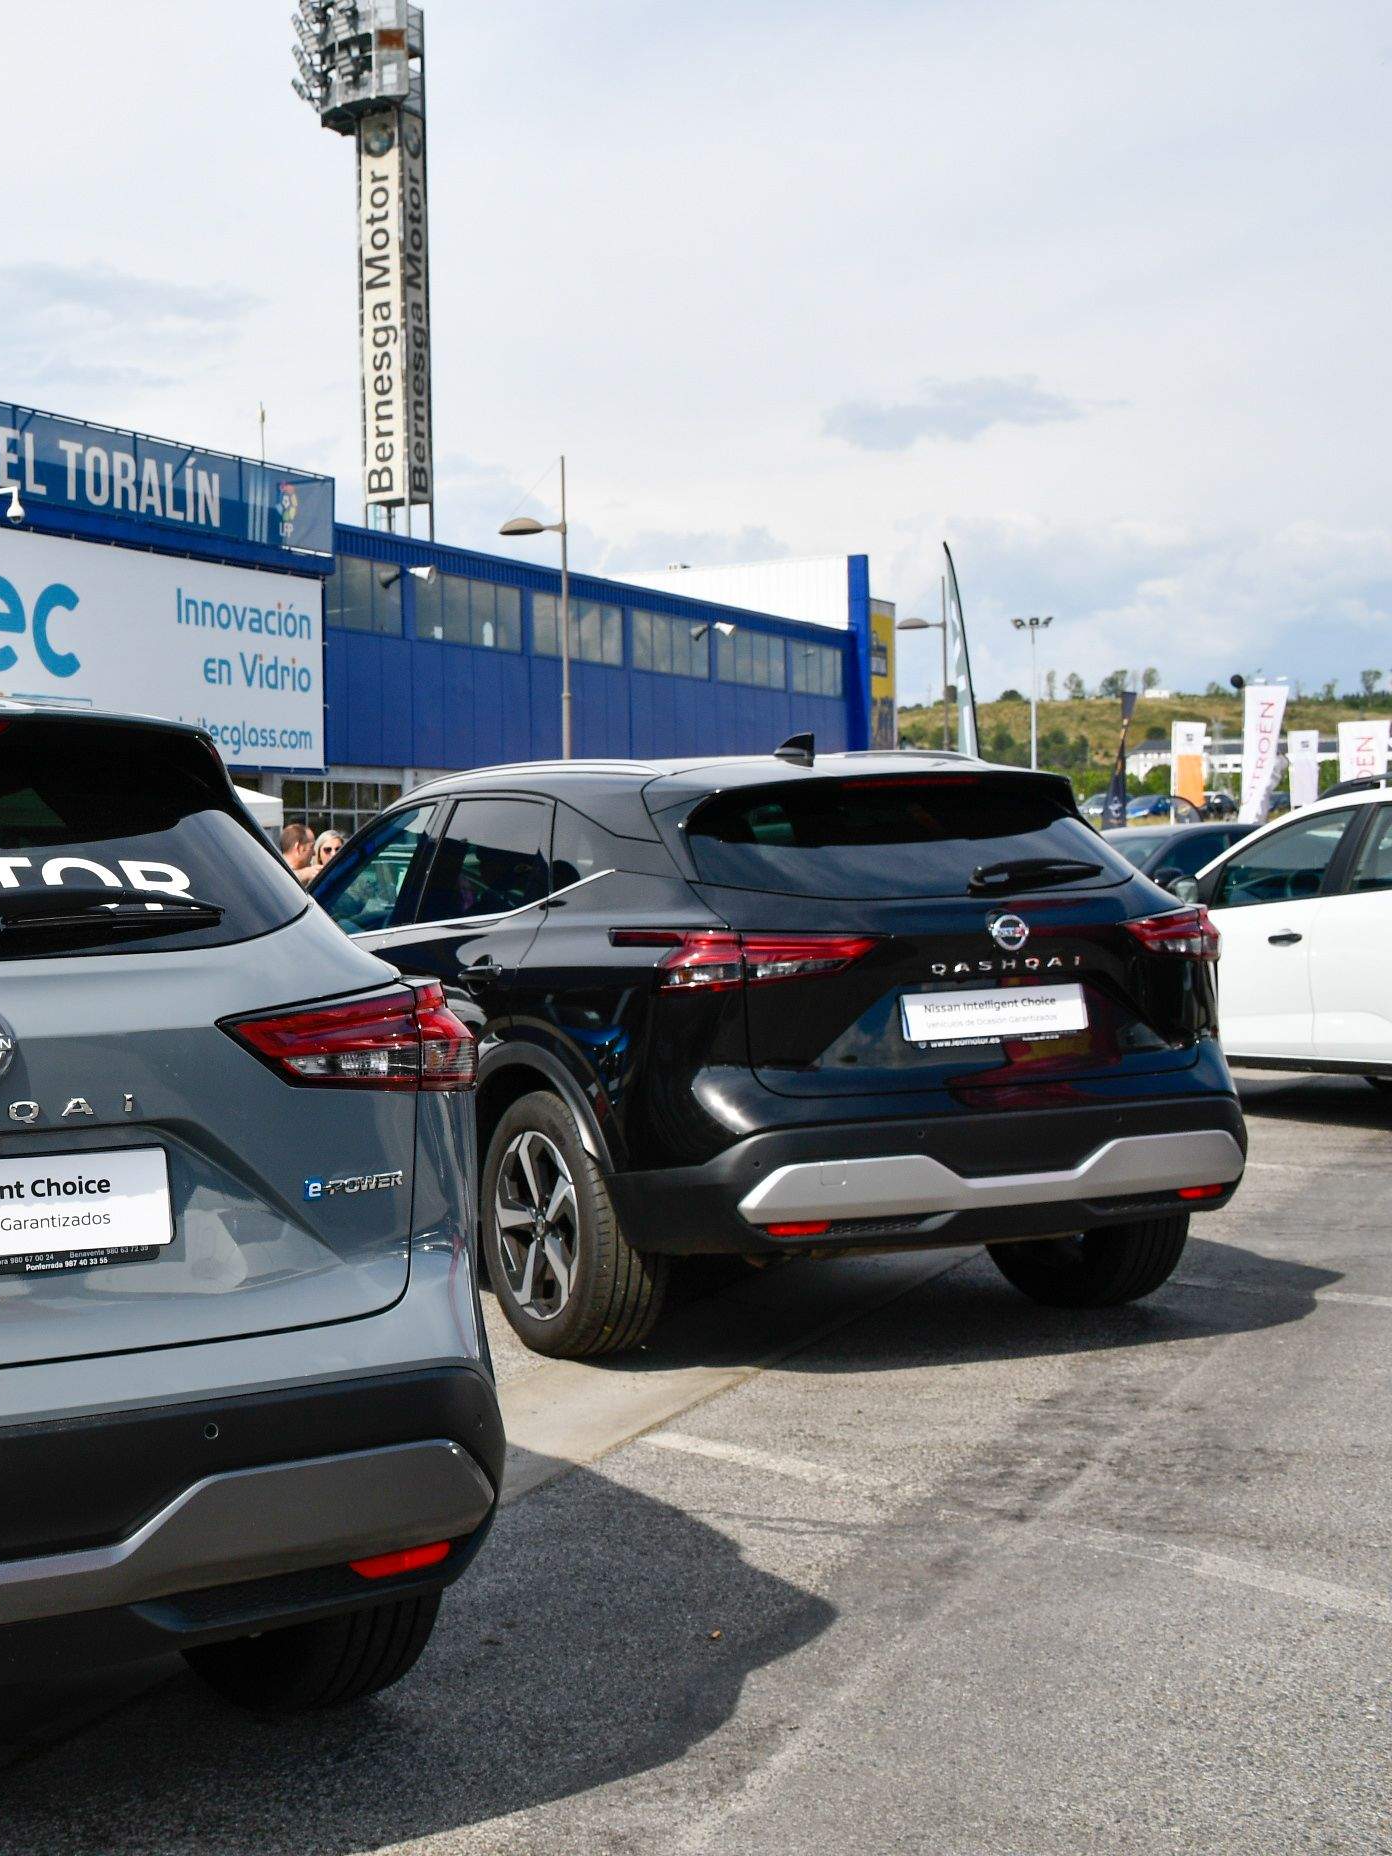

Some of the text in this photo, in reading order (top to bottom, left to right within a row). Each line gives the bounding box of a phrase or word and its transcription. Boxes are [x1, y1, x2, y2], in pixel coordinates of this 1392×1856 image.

[365, 170, 398, 494] Bernesga Motor
[407, 167, 429, 494] Bernesga Motor
[59, 439, 221, 528] TORALÍN
[176, 587, 312, 640] Innovación
[203, 651, 312, 693] en Vidrio
[179, 716, 313, 755] ecglass.com
[930, 954, 1082, 976] QASHQAI
[924, 996, 1056, 1014] Nissan Intelligent Choice
[30, 1175, 111, 1198] Choice
[309, 1170, 403, 1198] e-POWER
[0, 1212, 111, 1232] Garantizados
[25, 1261, 64, 1271] Ponferrada
[45, 1253, 55, 1261] 24
[69, 1249, 105, 1259] Benavente
